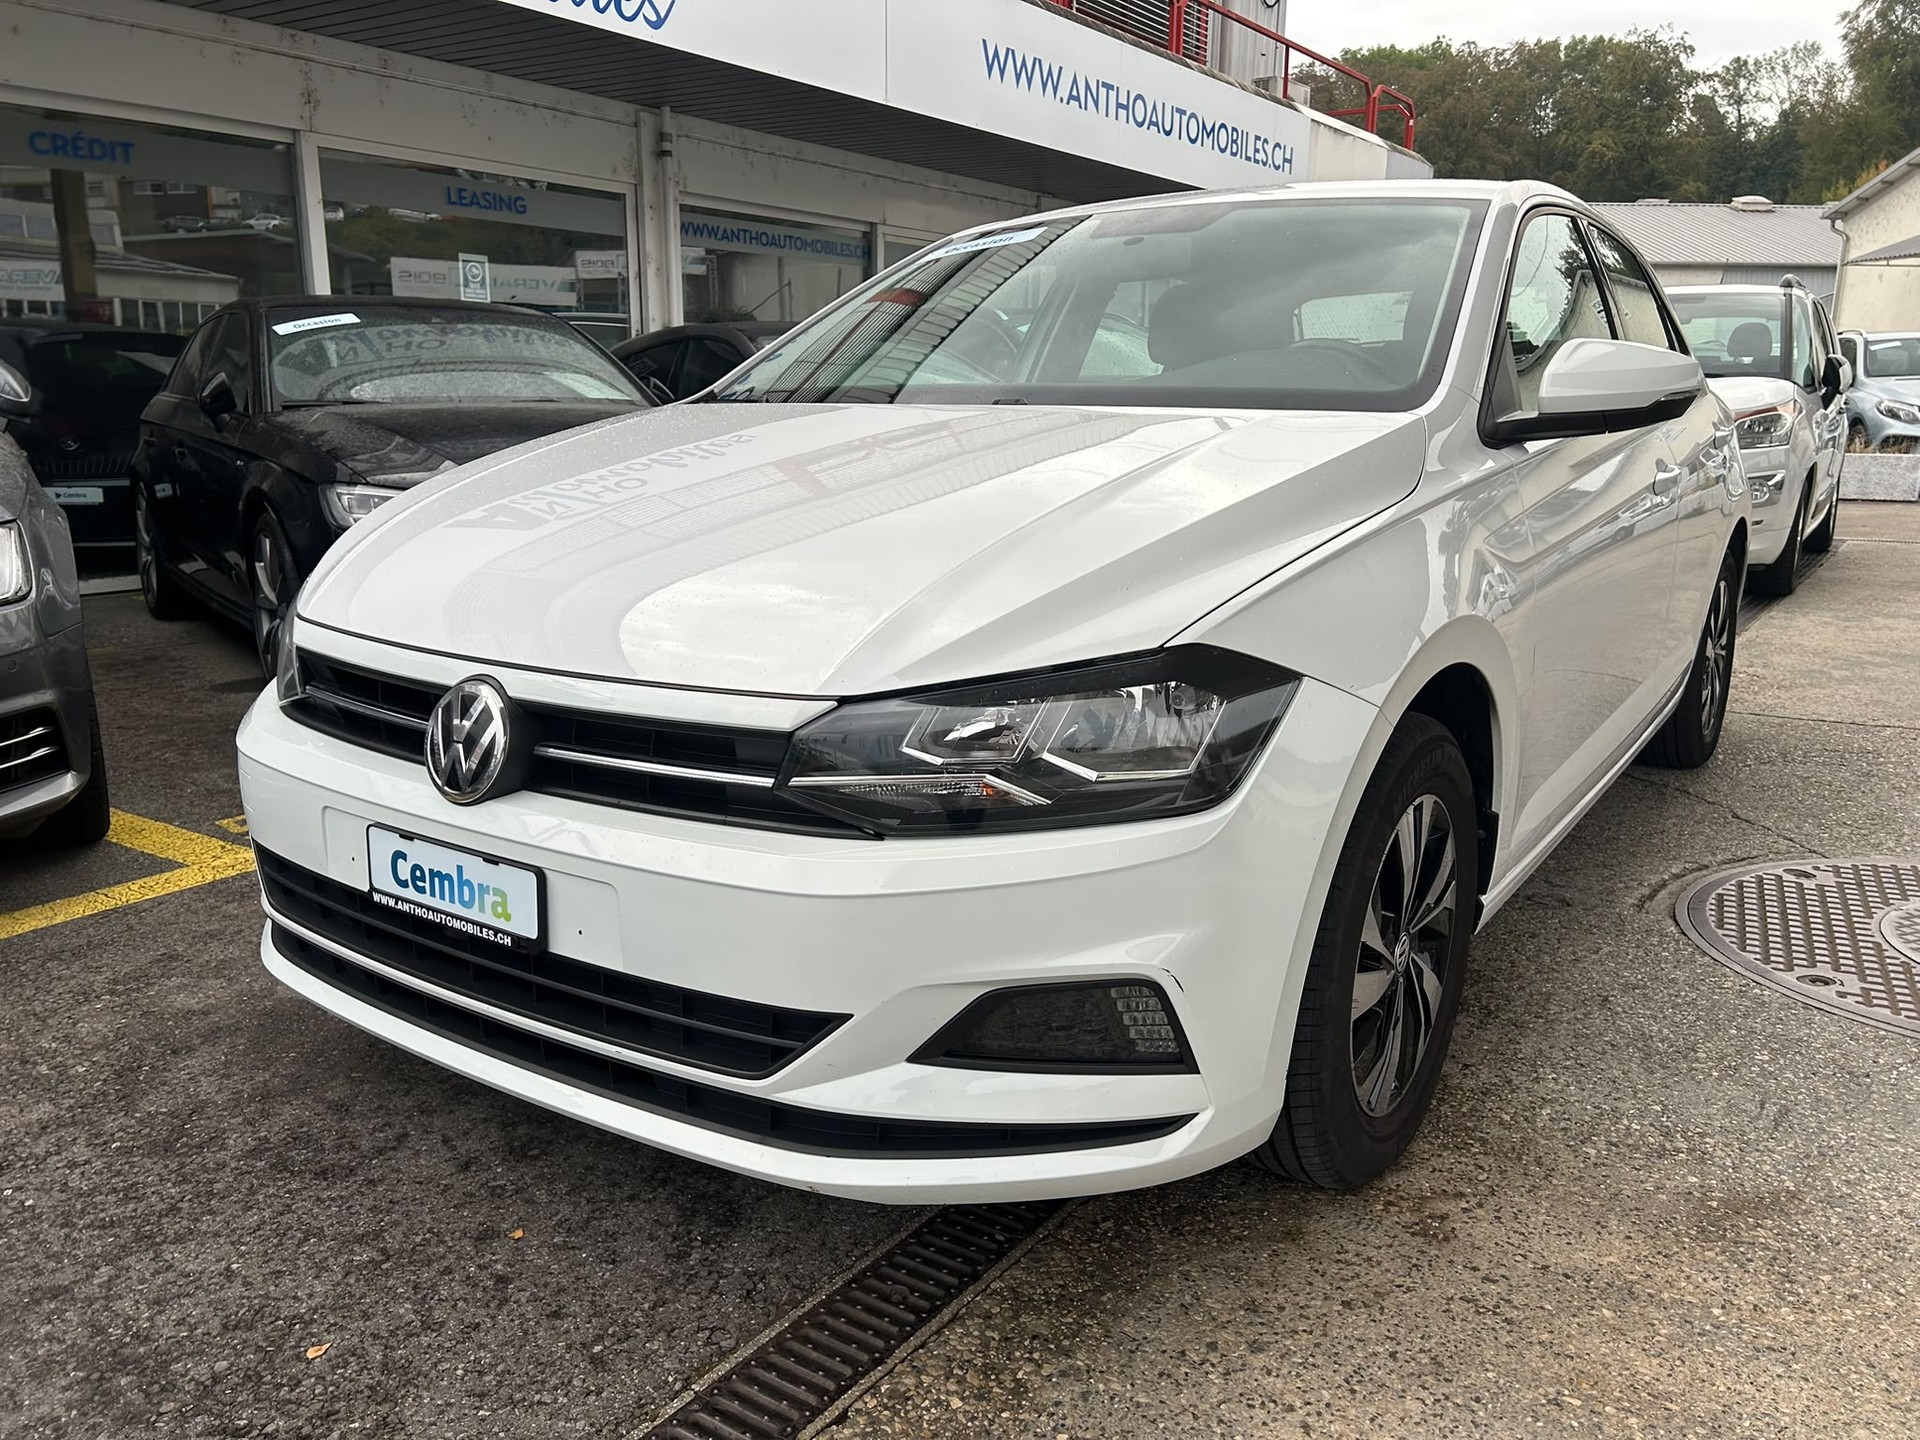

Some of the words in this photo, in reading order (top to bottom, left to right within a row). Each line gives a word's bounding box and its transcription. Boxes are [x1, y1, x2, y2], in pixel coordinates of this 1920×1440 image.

[981, 38, 1294, 175] WWW.ANTHOAUTOMOBILES.CH
[28, 130, 136, 164] CRÉDIT
[445, 185, 528, 215] LEASING
[390, 849, 512, 923] Cembra
[372, 891, 512, 947] WWW.ANTHOAUTOMOBILES.CH
